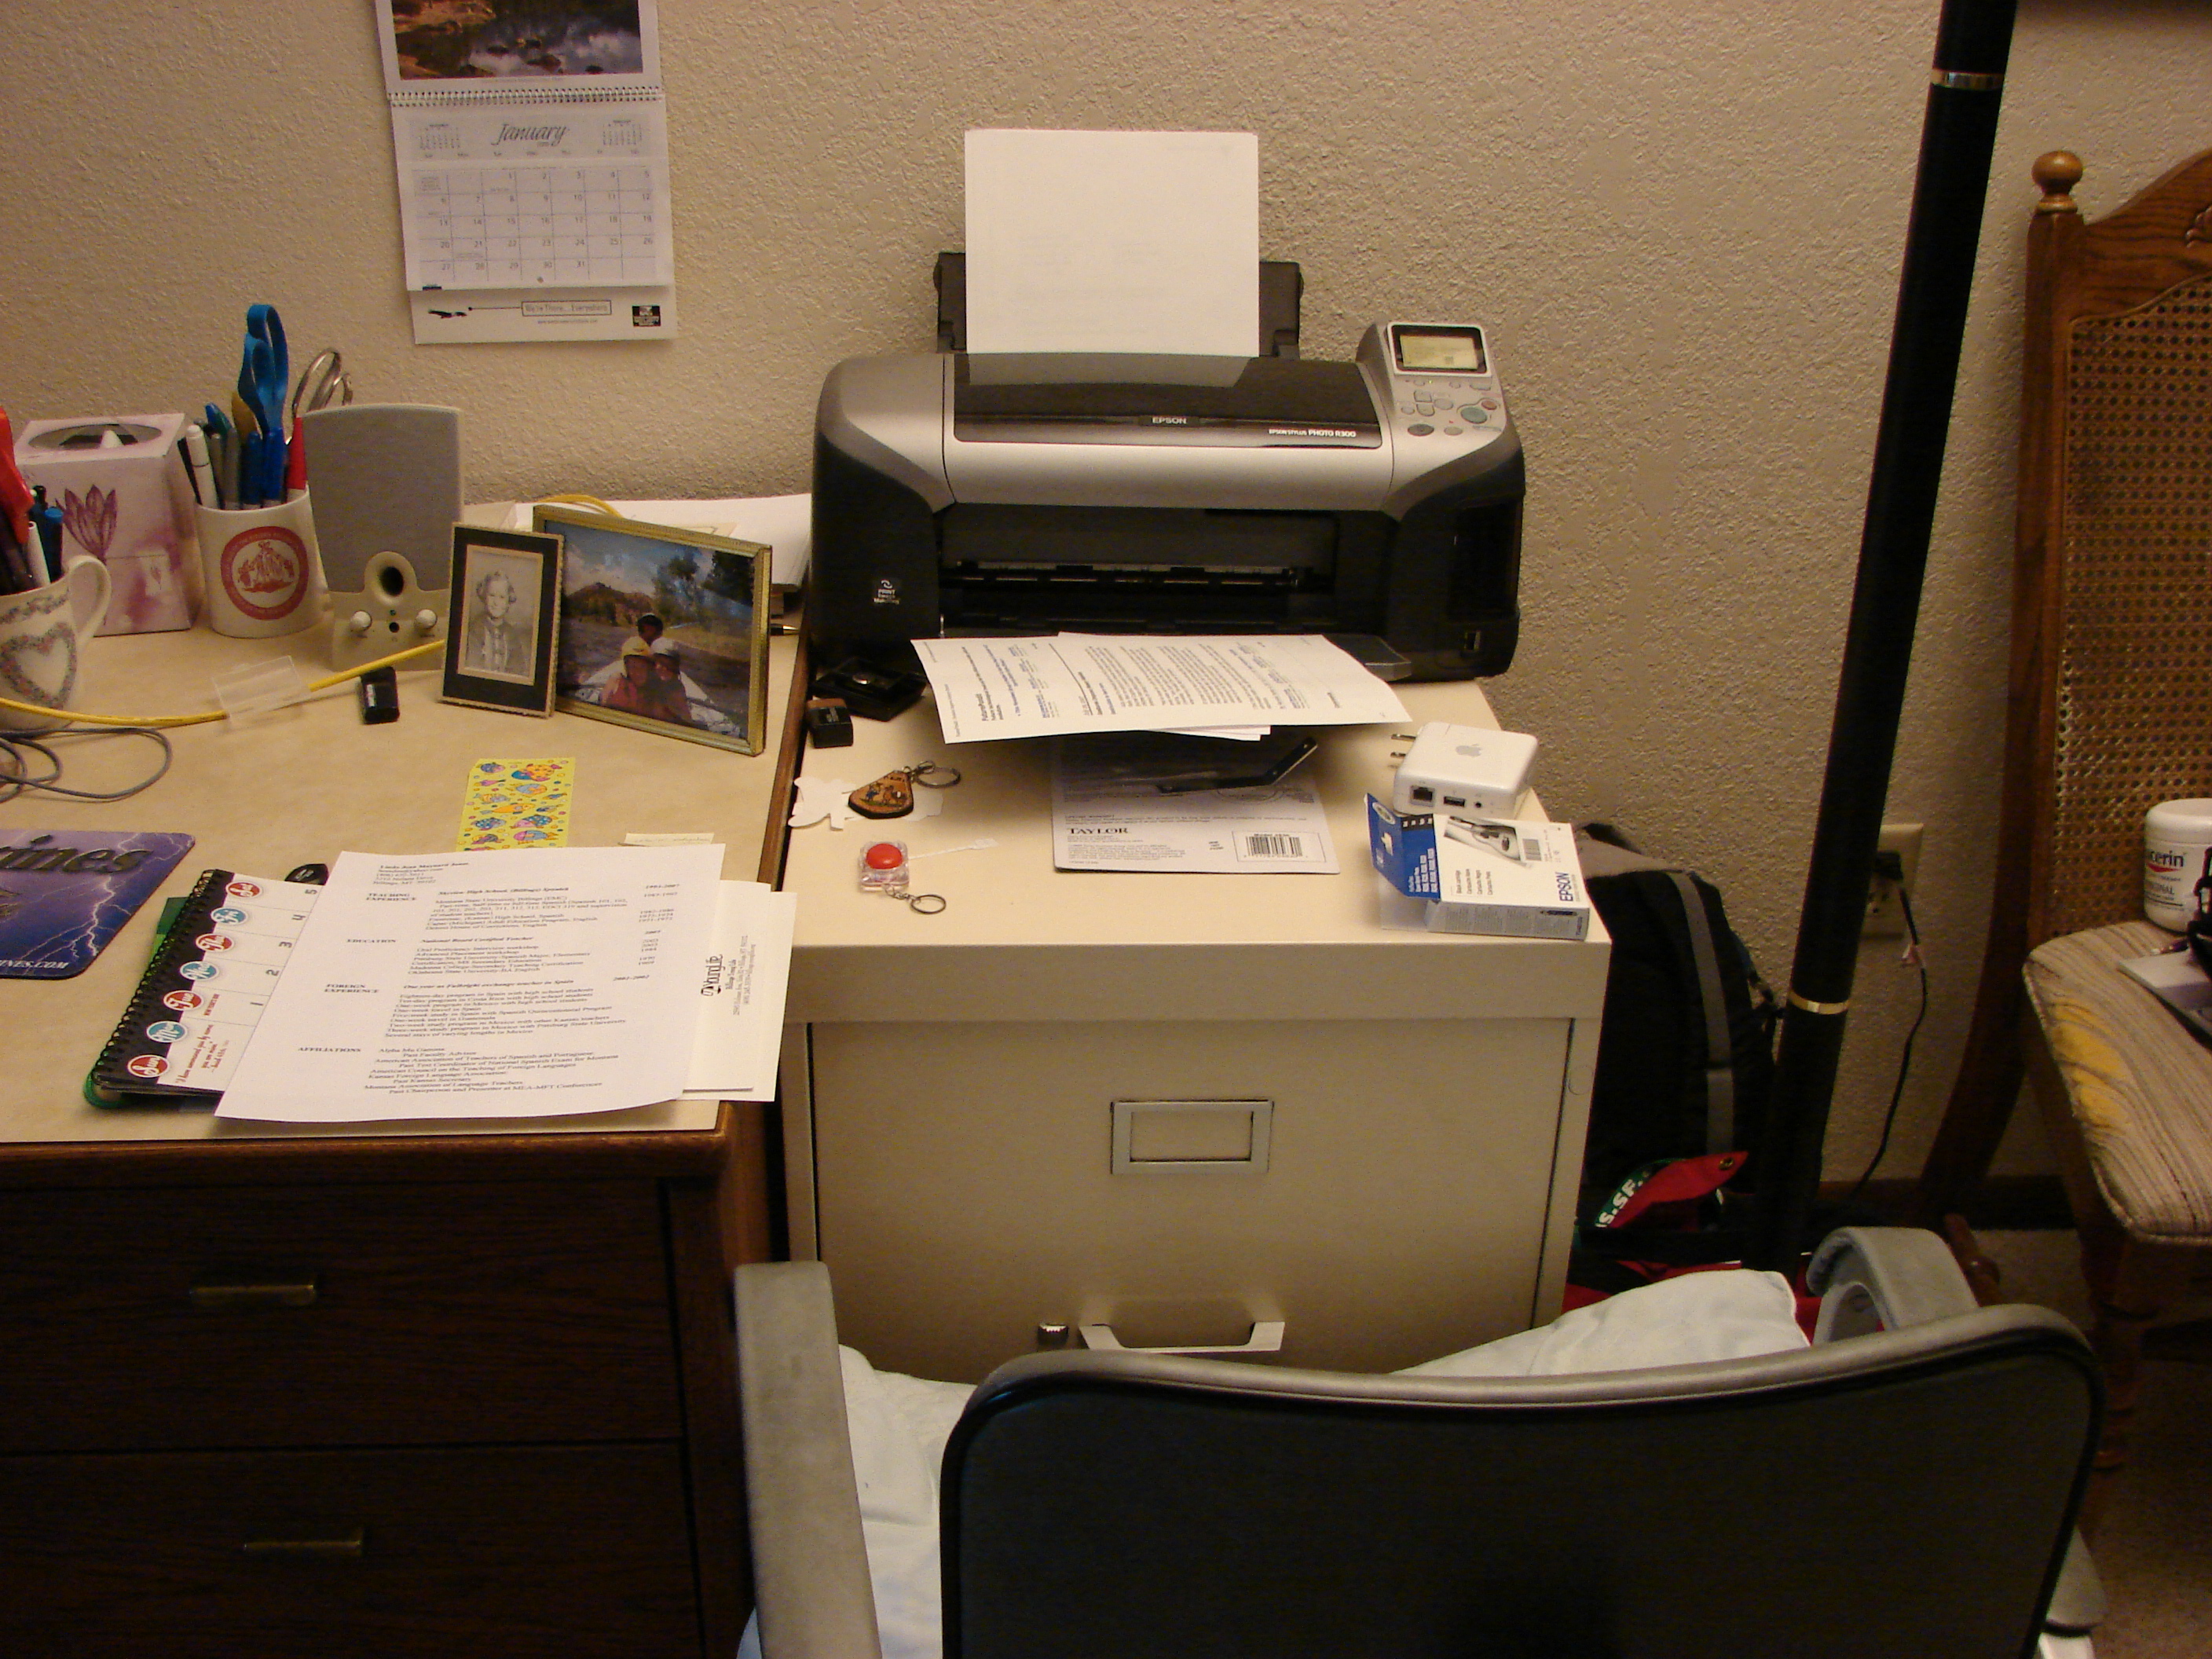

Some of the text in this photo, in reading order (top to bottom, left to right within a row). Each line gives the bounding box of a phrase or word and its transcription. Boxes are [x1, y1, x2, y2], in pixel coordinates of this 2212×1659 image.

[490, 123, 566, 147] January
[1152, 416, 1188, 424] EPSON
[0, 834, 154, 874] ines
[1555, 872, 1573, 901] EPSON
[266, 969, 280, 977] 2
[132, 1057, 160, 1077] Sun
